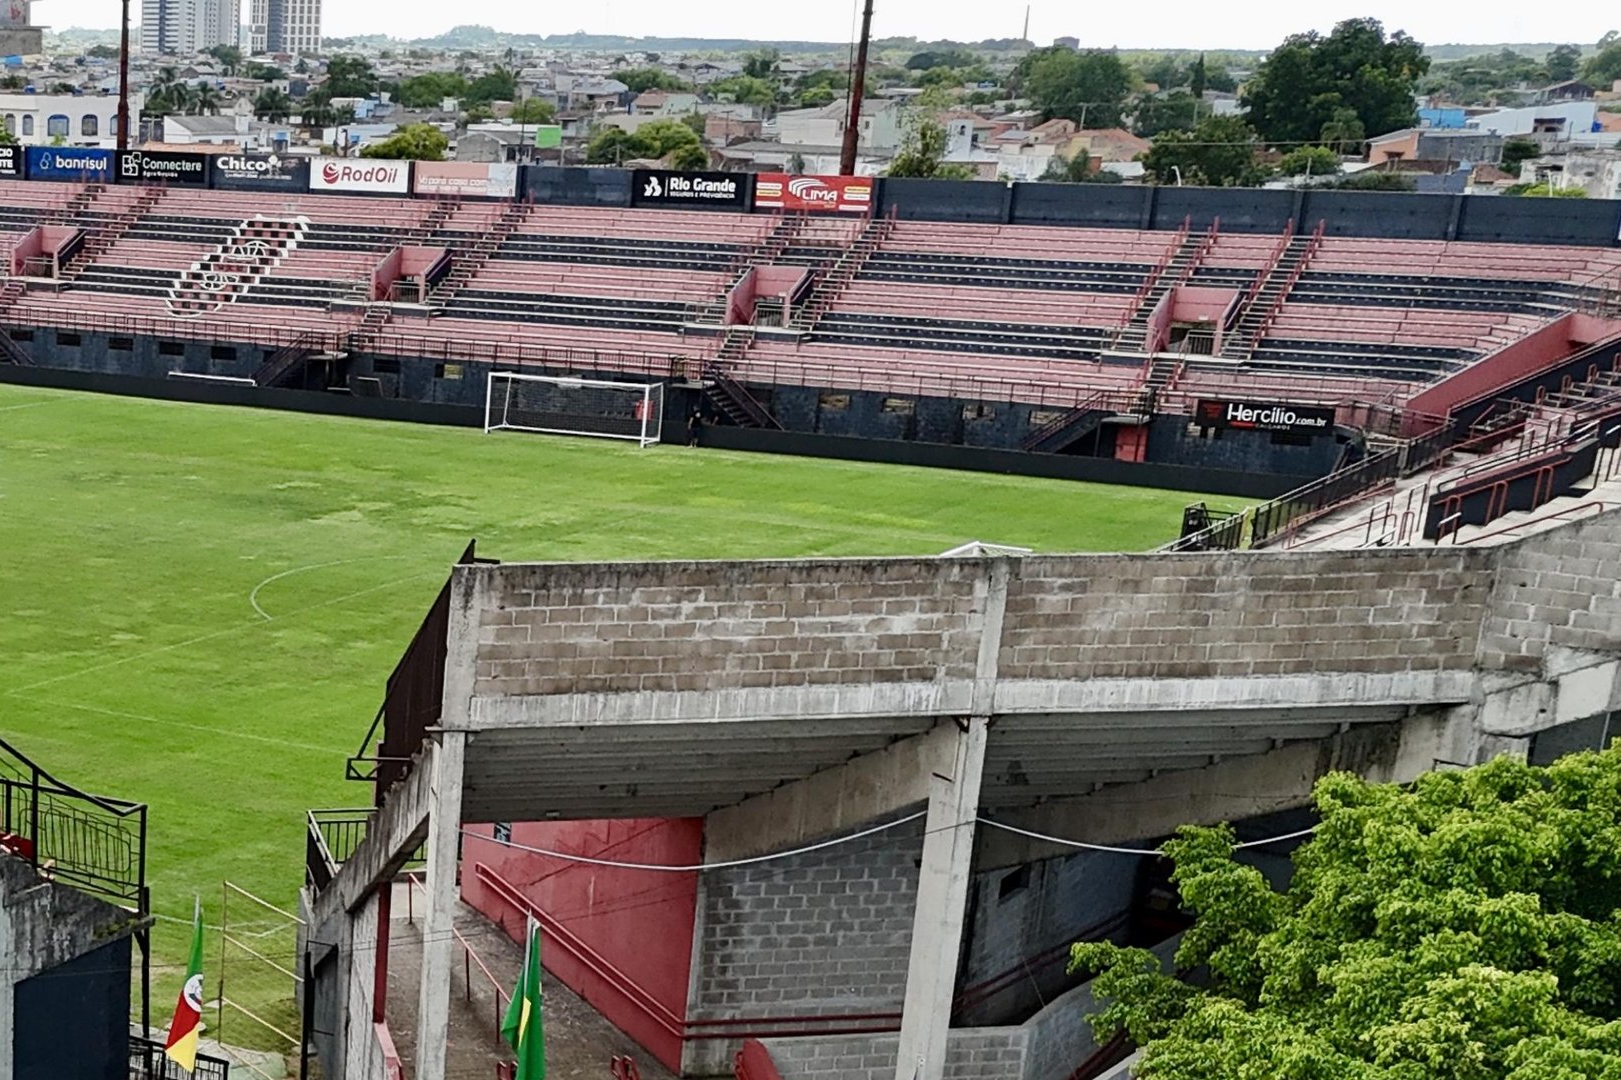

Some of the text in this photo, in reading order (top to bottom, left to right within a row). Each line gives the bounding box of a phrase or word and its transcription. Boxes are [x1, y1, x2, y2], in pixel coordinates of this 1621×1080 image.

[56, 155, 106, 170] banrisul
[142, 157, 202, 171] Connectere
[217, 156, 267, 171] Chico
[340, 166, 398, 183] RodOil
[670, 177, 736, 192] Rio Grande
[802, 189, 837, 201] LIMA
